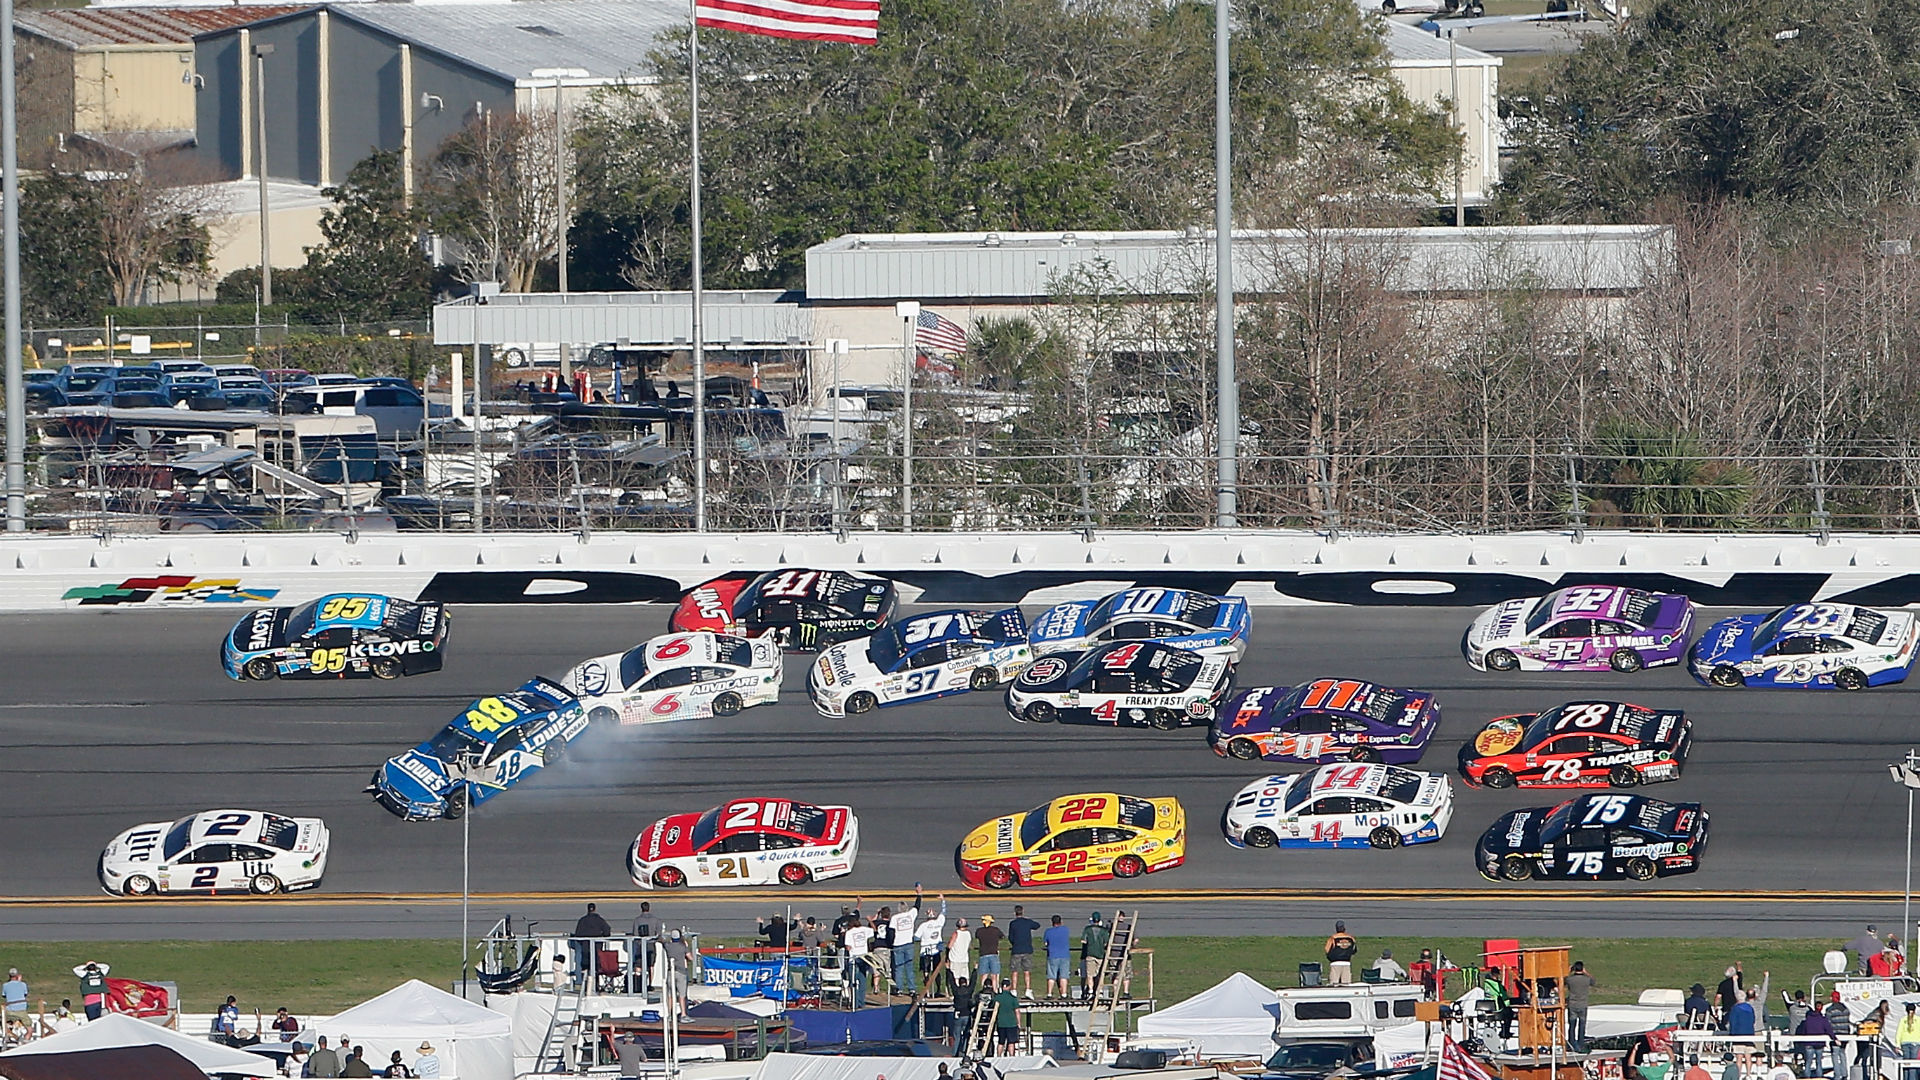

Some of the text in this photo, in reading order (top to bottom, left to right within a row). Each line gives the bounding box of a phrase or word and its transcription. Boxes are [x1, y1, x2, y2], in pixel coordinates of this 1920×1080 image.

[762, 570, 820, 597] 41
[319, 597, 371, 620] 95
[1114, 590, 1166, 614] 10
[1557, 588, 1613, 613] 32
[820, 619, 865, 628] MONSTER
[1045, 604, 1072, 638] Dental
[1060, 604, 1088, 636] Aspen
[1781, 604, 1836, 631] 23
[905, 615, 953, 644] 37
[1721, 628, 1743, 648] Best
[653, 637, 692, 661] 6
[1546, 641, 1584, 661] 32
[1615, 636, 1655, 647] WADE
[310, 648, 347, 674] 95
[830, 645, 856, 687] Cottonelle
[947, 655, 981, 670] Cottonelle
[1101, 643, 1144, 669] 4
[1834, 656, 1859, 668] Best
[906, 669, 941, 694] 37
[1774, 660, 1815, 683] 23
[690, 676, 759, 695] ADVOCARE
[1301, 679, 1364, 710] 11
[650, 692, 684, 715] 6
[1092, 700, 1119, 721] 4
[1126, 696, 1185, 705] FREAKY FAST!
[1232, 687, 1274, 728] FedEx
[466, 697, 518, 733] 48
[1397, 698, 1426, 727] FedEx
[1555, 704, 1610, 731] 78
[522, 709, 575, 752] LOWE'S
[1340, 733, 1394, 744] FedEx Express
[1504, 731, 1521, 746] Bass
[1655, 715, 1672, 742] TRACKER
[1293, 736, 1324, 758] 11
[1588, 750, 1655, 767] TRACKER
[398, 753, 448, 791] LOWE'S
[495, 751, 520, 785] 48
[1315, 765, 1372, 790] 14
[1542, 759, 1583, 782] 78
[1647, 769, 1670, 778] ROW
[1365, 771, 1383, 794] Mobil
[1236, 776, 1290, 818] Mobil 1
[1420, 784, 1436, 805] Mobil
[725, 802, 778, 829] 21
[1061, 798, 1107, 823] 22
[1355, 813, 1417, 827] Mobil 1
[1581, 795, 1634, 824] 75
[203, 813, 252, 837] 2
[998, 817, 1013, 854] PENNZOIL
[1309, 820, 1343, 841] 14
[648, 820, 667, 861] Motorcraft
[1096, 844, 1128, 854] Shell
[1135, 842, 1158, 853] PENNZOIL
[768, 851, 799, 861] Quick
[800, 849, 827, 858] Lane
[1047, 851, 1088, 874] 22
[1567, 851, 1605, 874] 75
[191, 866, 220, 888] 2
[716, 857, 750, 879] 21
[704, 968, 755, 985] BUSCH
